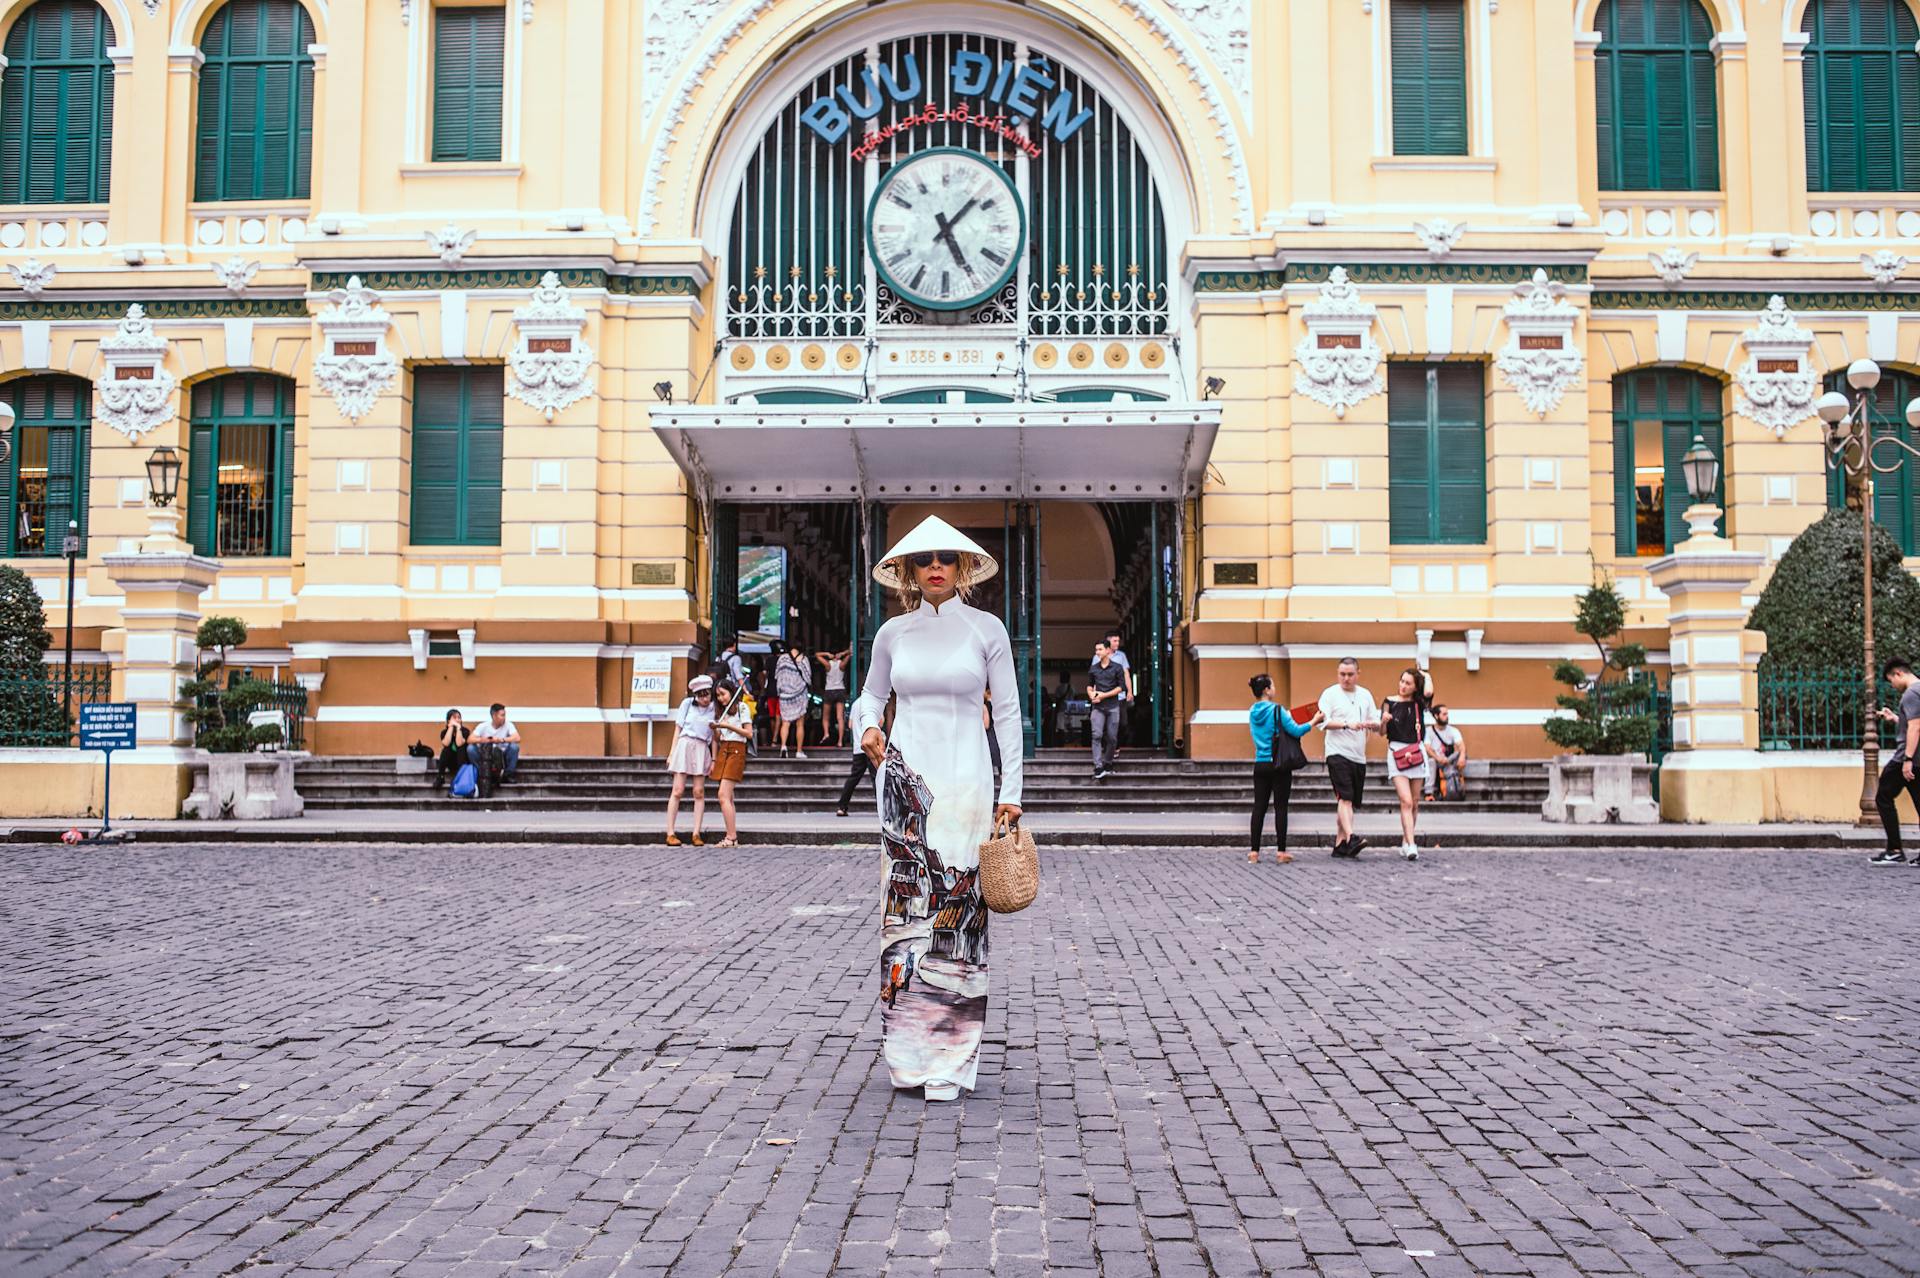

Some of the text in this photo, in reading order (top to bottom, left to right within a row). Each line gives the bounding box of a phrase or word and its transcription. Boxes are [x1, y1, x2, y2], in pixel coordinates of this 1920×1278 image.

[800, 49, 1094, 144] BƯU ĐIỆN
[851, 101, 1042, 161] THÀNH PHỐ HỒ CHÍ MINH
[957, 350, 984, 364] 1891
